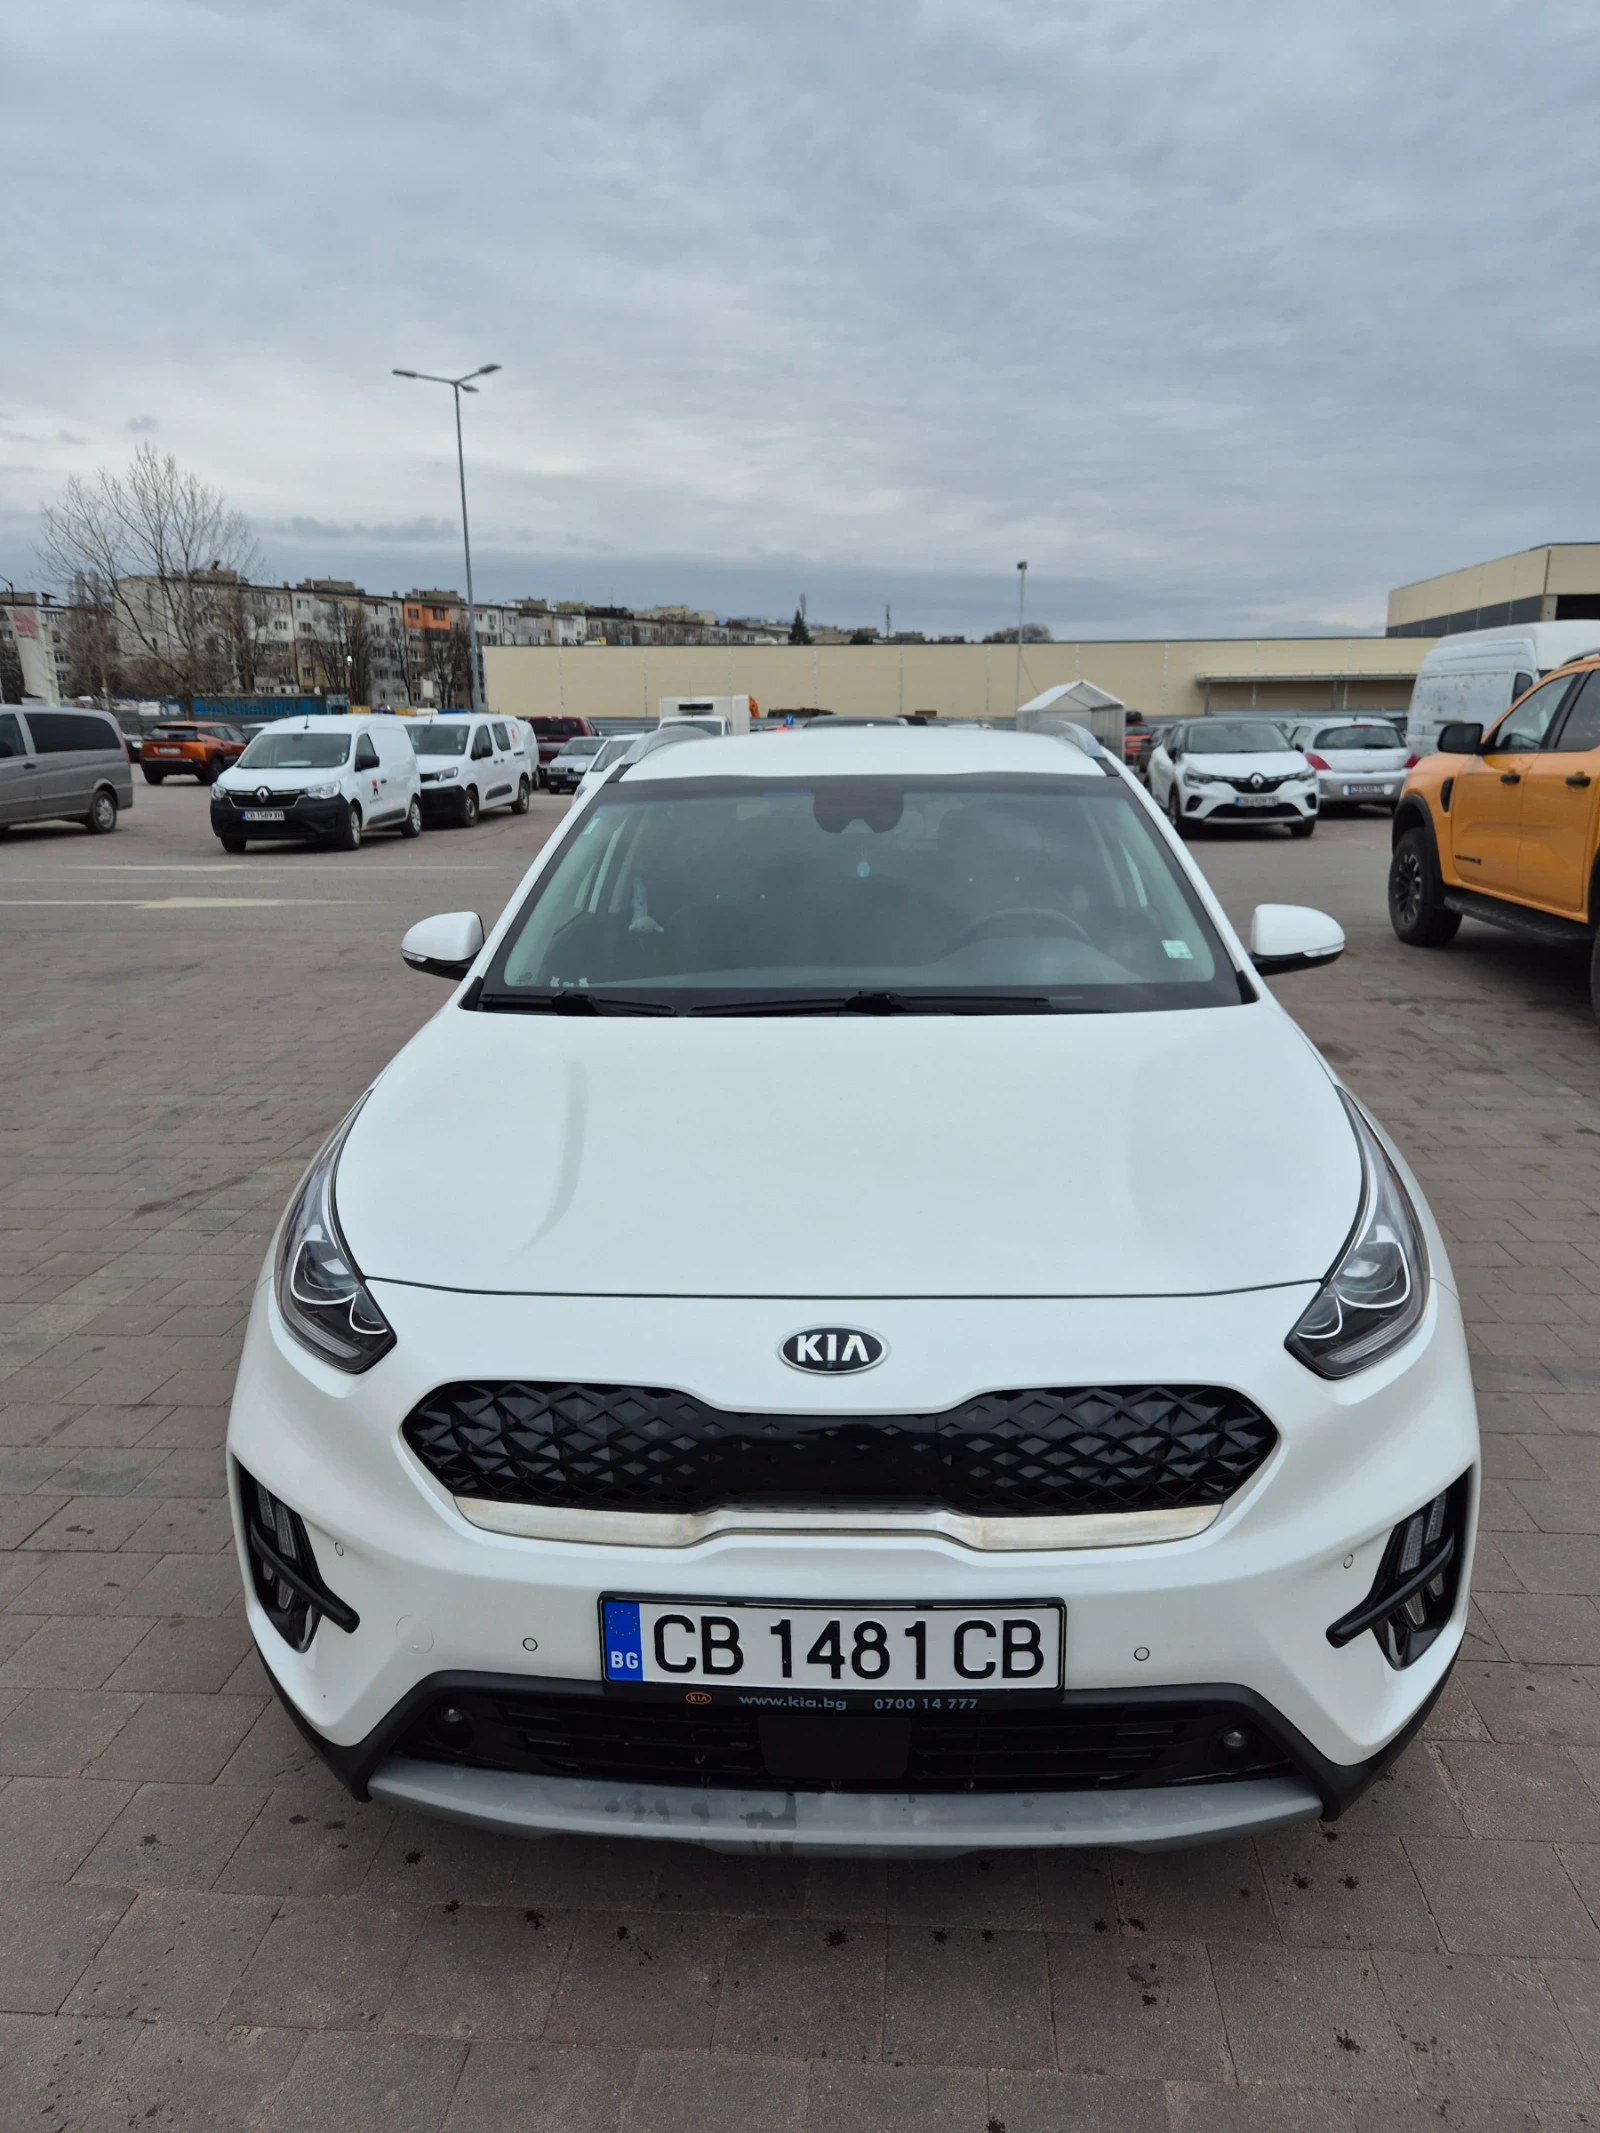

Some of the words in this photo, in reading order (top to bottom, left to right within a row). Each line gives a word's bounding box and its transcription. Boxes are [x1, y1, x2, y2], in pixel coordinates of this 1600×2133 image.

[797, 1334, 870, 1362] KIA
[654, 1614, 744, 1675] CB
[770, 1619, 926, 1680] 1481
[954, 1619, 1044, 1680] CB
[611, 1651, 639, 1669] BG
[690, 1694, 708, 1702] KIA
[739, 1696, 847, 1710] www.kia.bg
[874, 1698, 916, 1710] 0700
[922, 1698, 942, 1710] 14
[947, 1698, 979, 1710] 777
